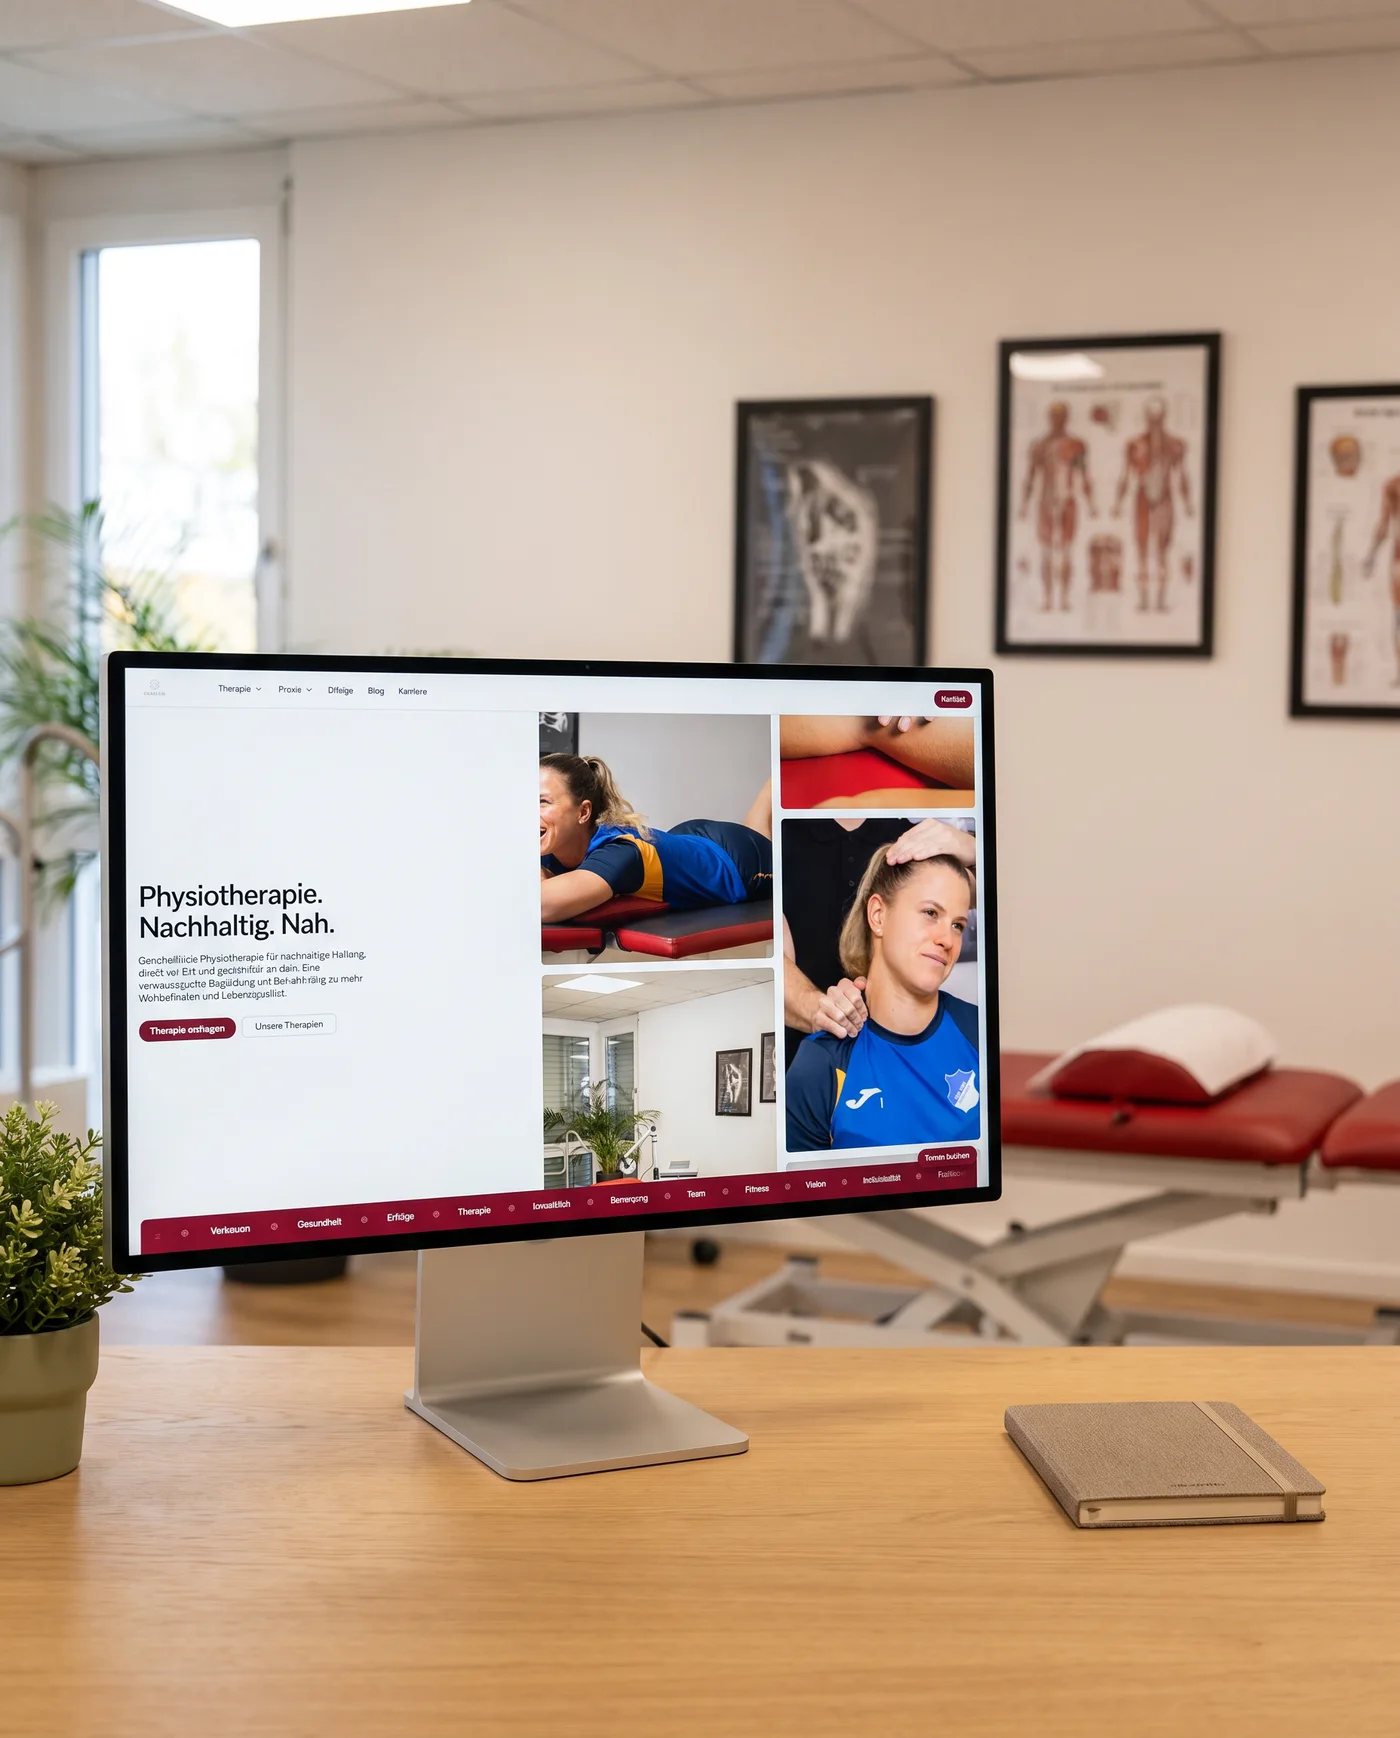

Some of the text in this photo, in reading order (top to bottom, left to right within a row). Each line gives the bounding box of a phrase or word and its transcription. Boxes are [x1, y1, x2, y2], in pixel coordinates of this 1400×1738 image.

[218, 684, 252, 694] Therapie
[367, 686, 385, 696] Blog
[140, 882, 323, 913] Physiotherapie.
[140, 912, 335, 941] Nachhaltig. Nah.
[200, 953, 264, 965] Physiotherapie
[266, 952, 278, 961] für
[197, 967, 215, 976] und
[302, 963, 320, 972] Eine
[328, 976, 338, 984] zu
[340, 974, 363, 983] mehr
[202, 991, 219, 1001] und
[150, 1026, 186, 1036] Therapie
[255, 1020, 323, 1031] Unsere Therapien
[297, 1217, 342, 1230] Gesundheit
[457, 1206, 491, 1217] Therapie
[687, 1190, 706, 1199] Team
[745, 1184, 770, 1194] Fitness
